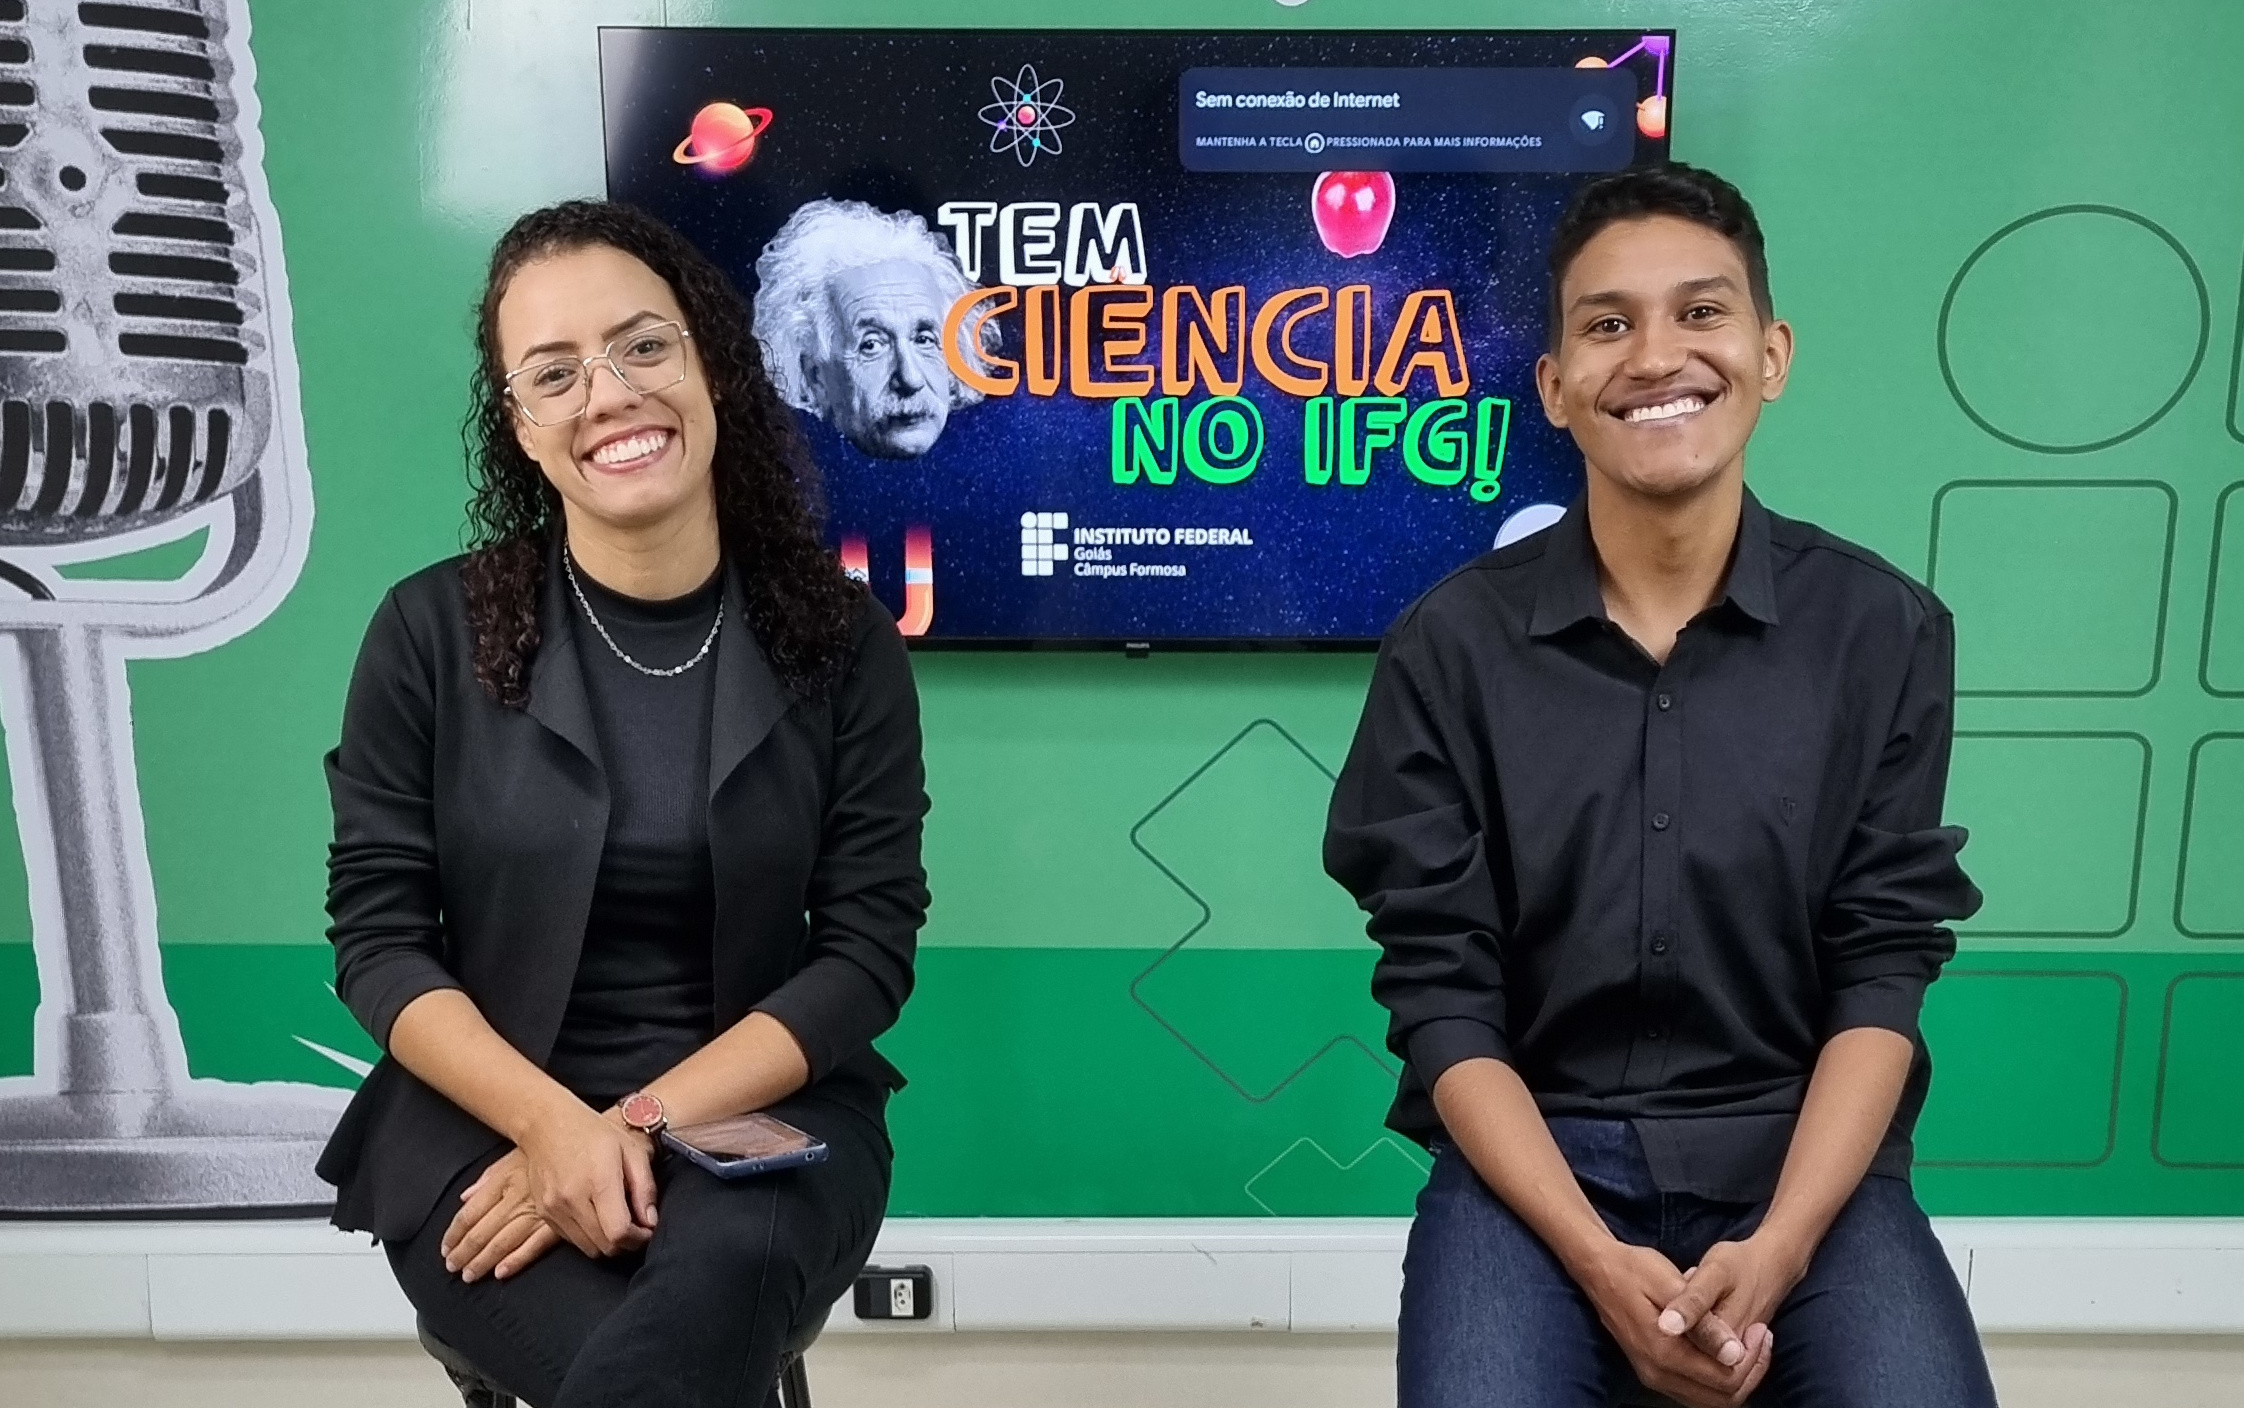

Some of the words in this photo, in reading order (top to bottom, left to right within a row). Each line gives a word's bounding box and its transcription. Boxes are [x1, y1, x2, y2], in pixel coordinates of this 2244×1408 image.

[1195, 91, 1232, 108] Sem
[1235, 91, 1306, 108] conexão
[1308, 91, 1331, 108] de
[1333, 91, 1400, 108] Internet
[1195, 137, 1257, 147] MANTENHA
[1258, 137, 1268, 147] A
[1269, 137, 1303, 147] TECLA
[1326, 136, 1401, 147] PRESSIONADA
[1403, 136, 1432, 147] PARA
[1434, 136, 1461, 147] MAIS
[1463, 135, 1543, 149] INFORMAÇÕES
[938, 202, 1147, 285] TEM
[1112, 395, 1265, 485] NO
[1305, 396, 1512, 502] IFG!
[1073, 527, 1171, 545] INSTITUTO
[1174, 527, 1254, 545] FEDERAL
[1073, 545, 1113, 561] Goiás
[1073, 562, 1128, 579] Câmpus
[1129, 562, 1187, 577] Formosa
